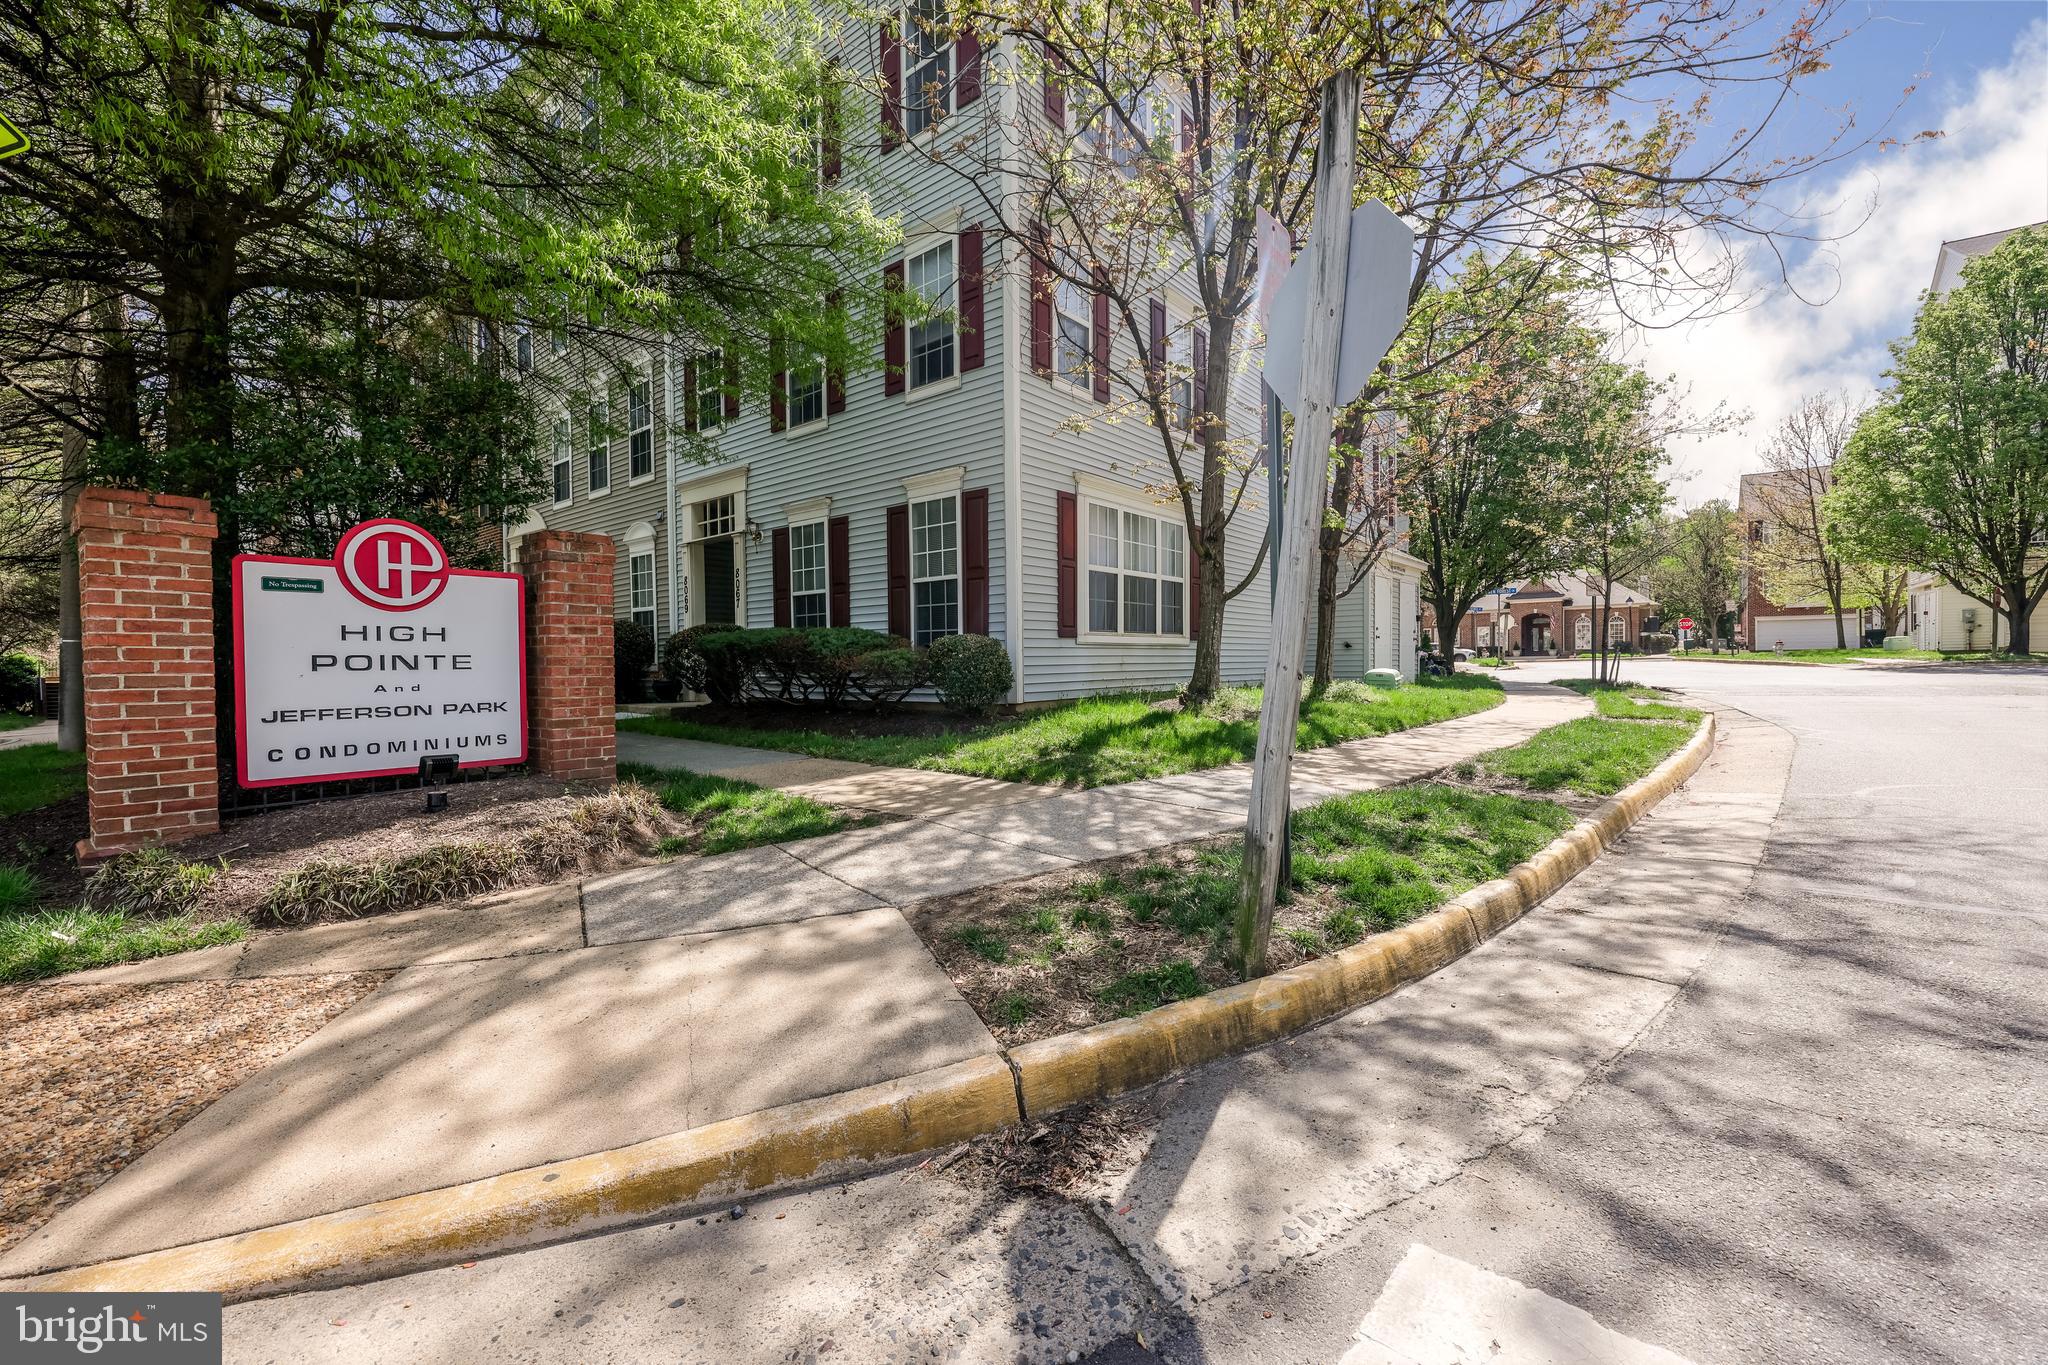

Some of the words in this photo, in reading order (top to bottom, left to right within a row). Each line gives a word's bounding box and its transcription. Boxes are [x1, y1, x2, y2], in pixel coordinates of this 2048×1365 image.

[280, 581, 317, 589] Trespassing
[340, 625, 446, 642] HIGH
[311, 654, 472, 672] POINTE
[373, 684, 421, 693] And
[261, 705, 432, 723] JEFFERSON
[443, 702, 508, 715] PARK
[267, 734, 507, 762] CONDOMINIUMS
